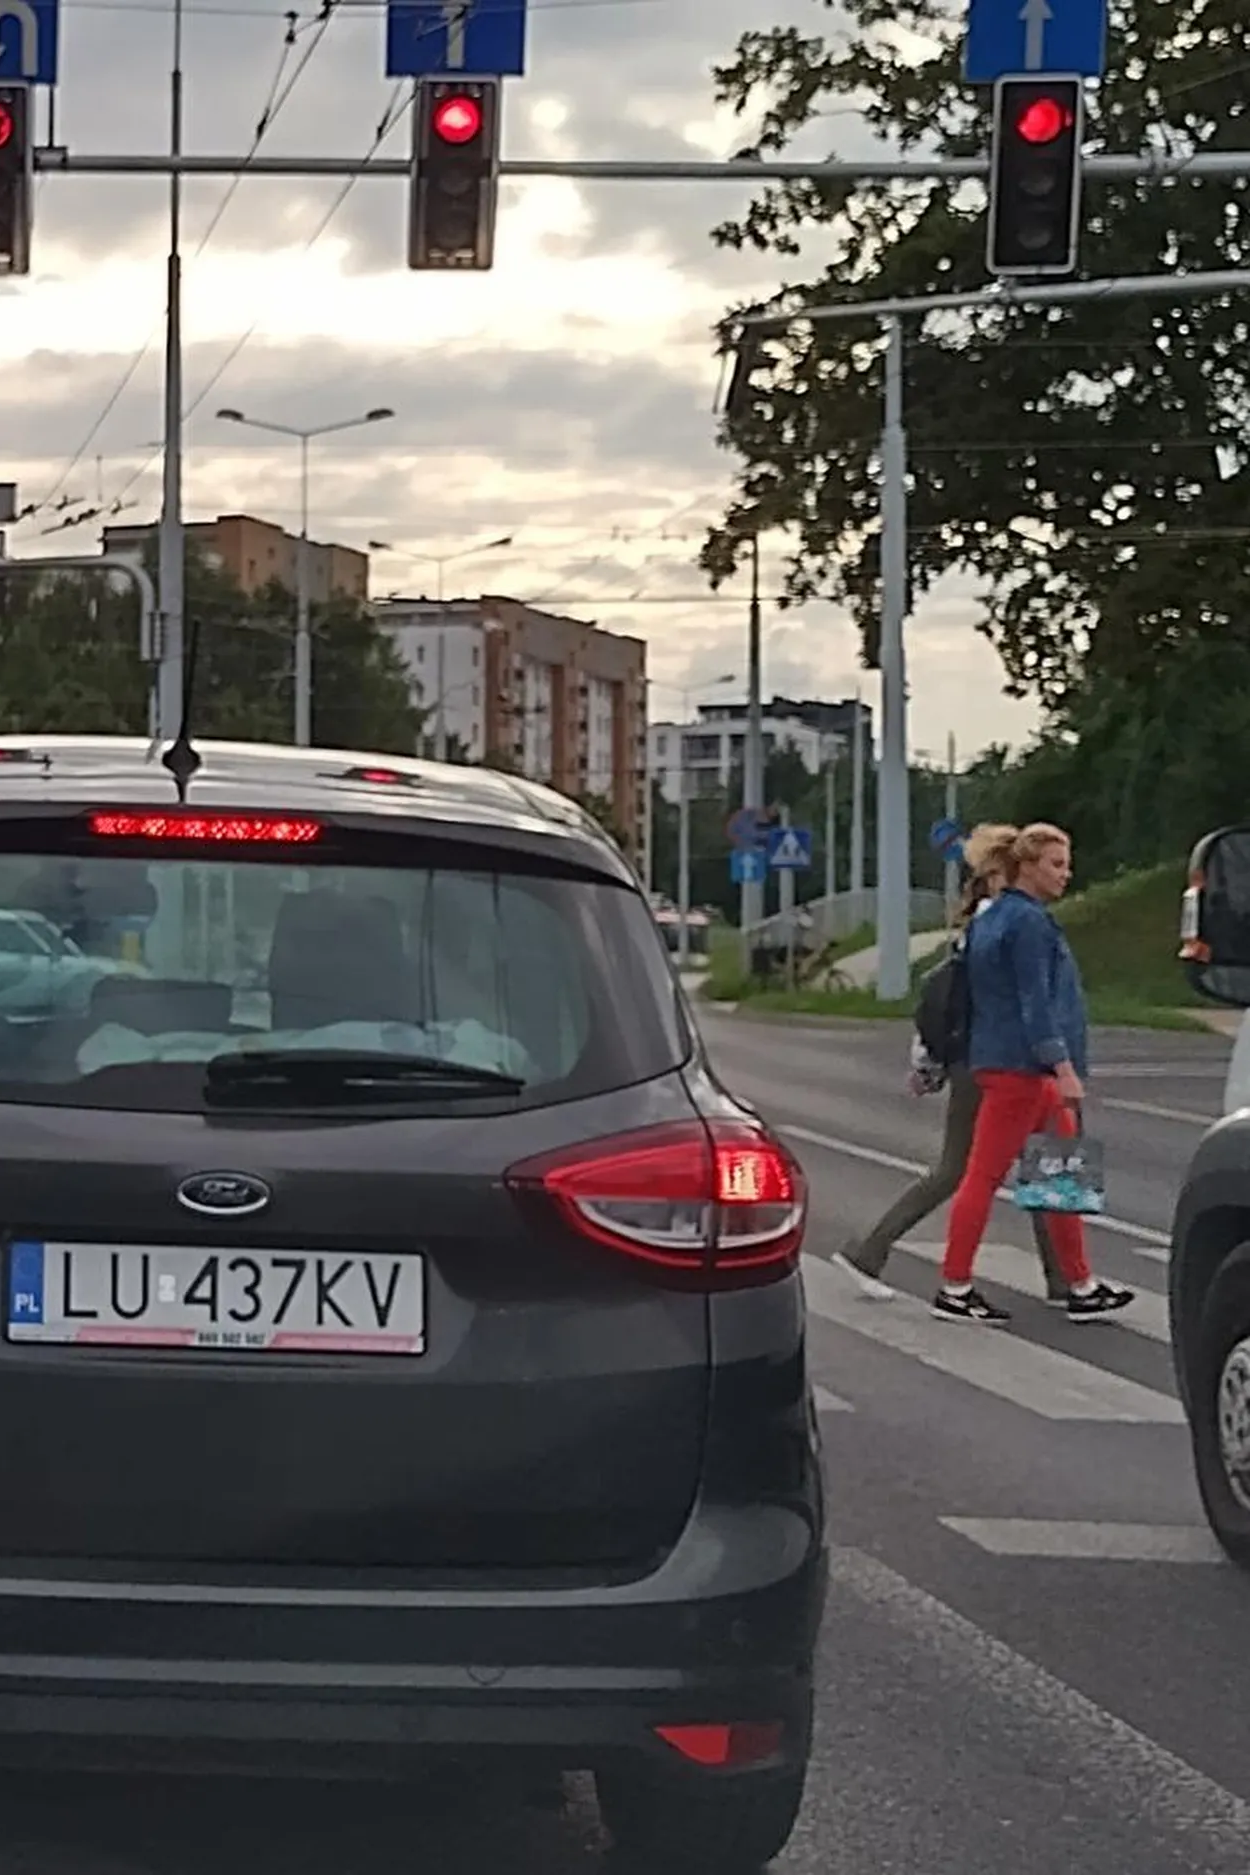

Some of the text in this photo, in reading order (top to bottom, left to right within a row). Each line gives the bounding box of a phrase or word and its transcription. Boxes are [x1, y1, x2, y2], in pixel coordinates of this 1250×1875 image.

[14, 1293, 40, 1313] PL
[62, 1251, 402, 1328] LU 437KV
